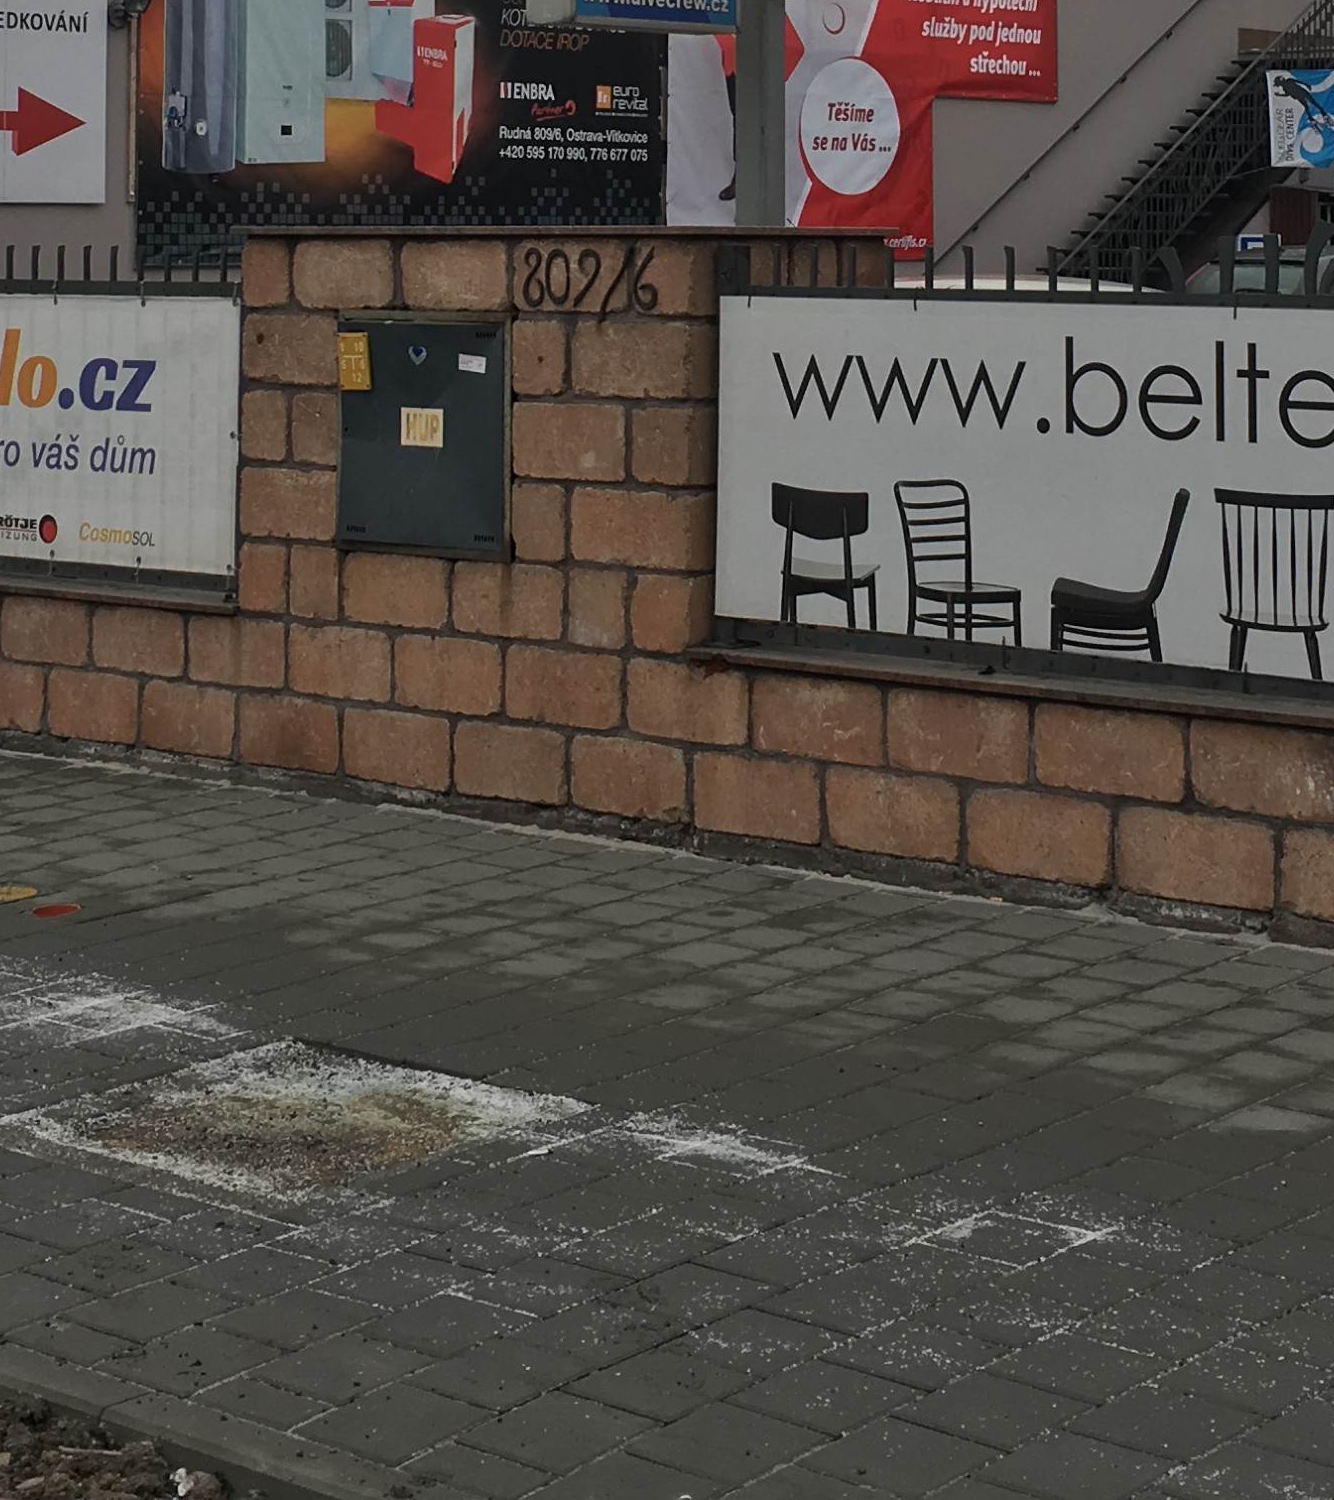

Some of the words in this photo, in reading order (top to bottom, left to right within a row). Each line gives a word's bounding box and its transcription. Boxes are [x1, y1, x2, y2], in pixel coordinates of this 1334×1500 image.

[500, 30, 555, 50] DOTACE
[557, 33, 589, 50] IROP
[921, 16, 967, 45] služby
[968, 21, 995, 45] pod
[995, 21, 1042, 47] jednou
[970, 51, 1027, 76] střechou
[513, 83, 555, 100] ENBRA
[613, 86, 639, 98] euro
[613, 98, 648, 110] revital
[827, 102, 874, 122] Těšíme
[499, 126, 531, 140] Rudná
[1285, 108, 1294, 140] CENTER
[812, 136, 828, 151] se
[830, 137, 848, 151] na
[851, 133, 876, 152] Vás
[499, 145, 524, 159] +420
[526, 146, 545, 159] 595
[548, 147, 564, 160] 170
[567, 147, 588, 162] 990,
[590, 148, 608, 160] 776
[610, 149, 628, 161] 677
[630, 149, 648, 161] 075
[523, 245, 658, 323] 809/6
[31, 434, 80, 471] váš
[90, 435, 157, 475] dům
